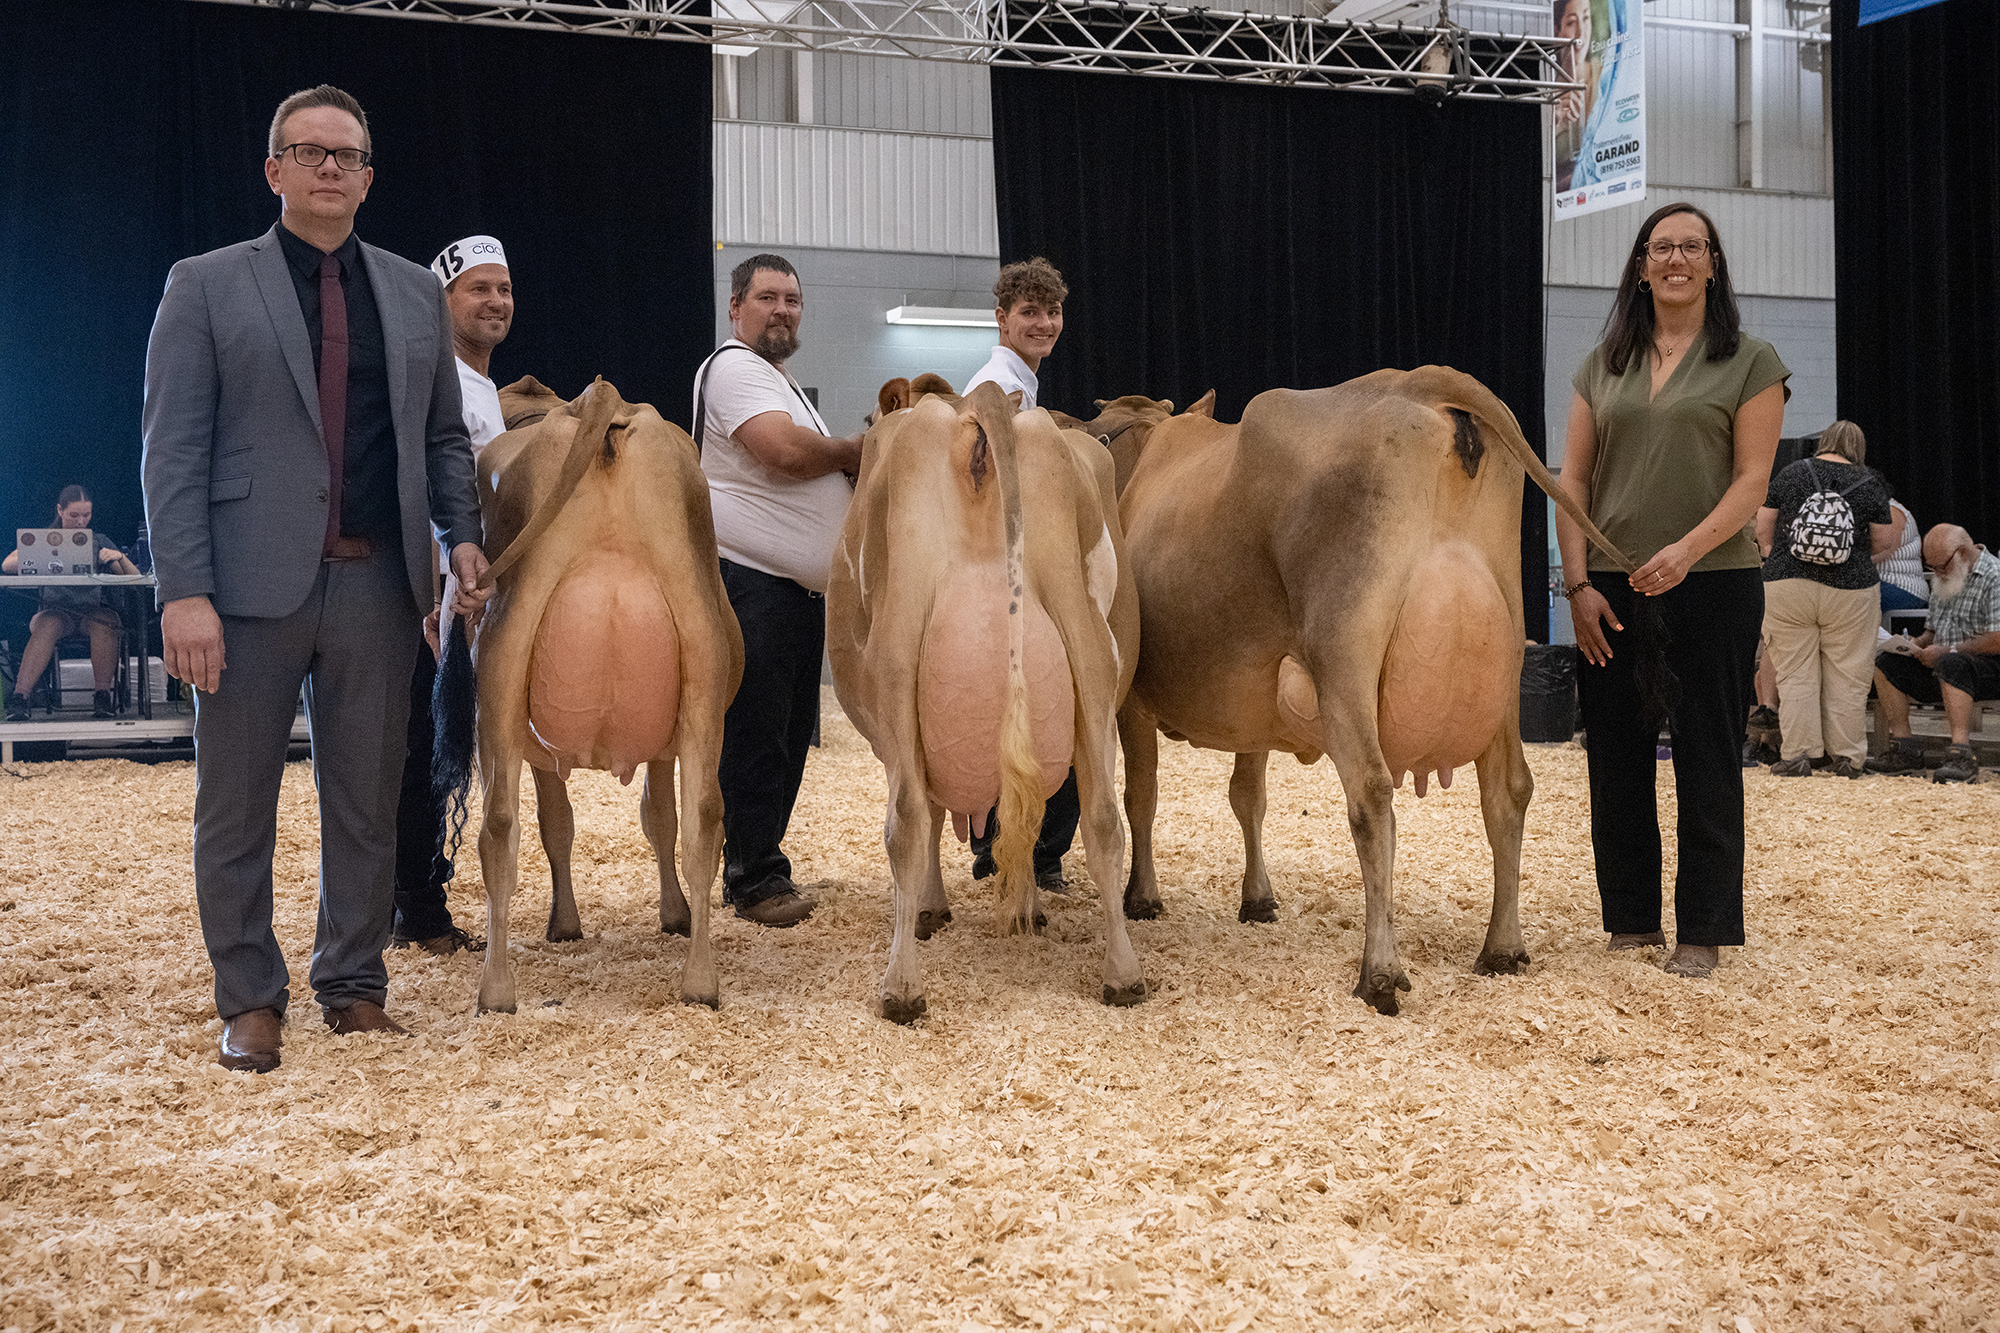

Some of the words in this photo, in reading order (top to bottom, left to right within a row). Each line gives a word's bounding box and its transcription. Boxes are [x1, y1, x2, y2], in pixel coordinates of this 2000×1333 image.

[1591, 40, 1606, 53] Eau
[1595, 140, 1640, 163] GARAND
[1601, 163, 1614, 175] (819)
[440, 244, 464, 280] 15
